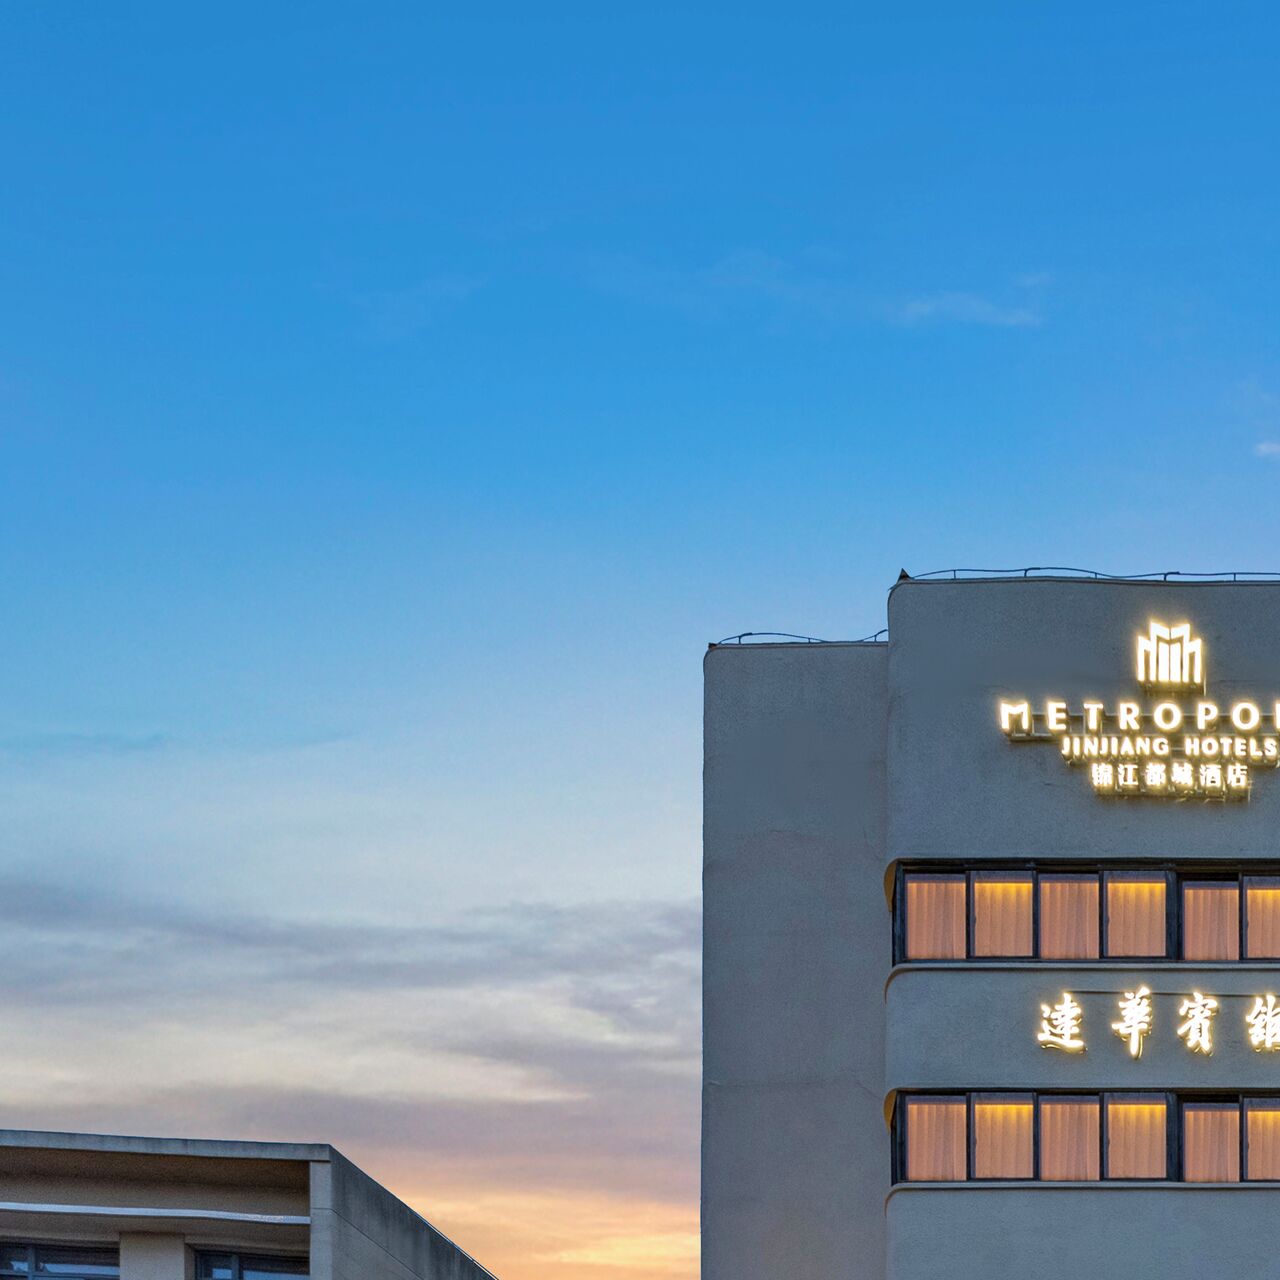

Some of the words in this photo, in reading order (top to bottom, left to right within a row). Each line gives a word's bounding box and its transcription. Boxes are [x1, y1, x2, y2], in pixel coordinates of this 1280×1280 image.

[1060, 736, 1170, 757] JINJIANG
[1184, 736, 1279, 758] HOTELS
[1091, 763, 1249, 788] 锦江都城酒店
